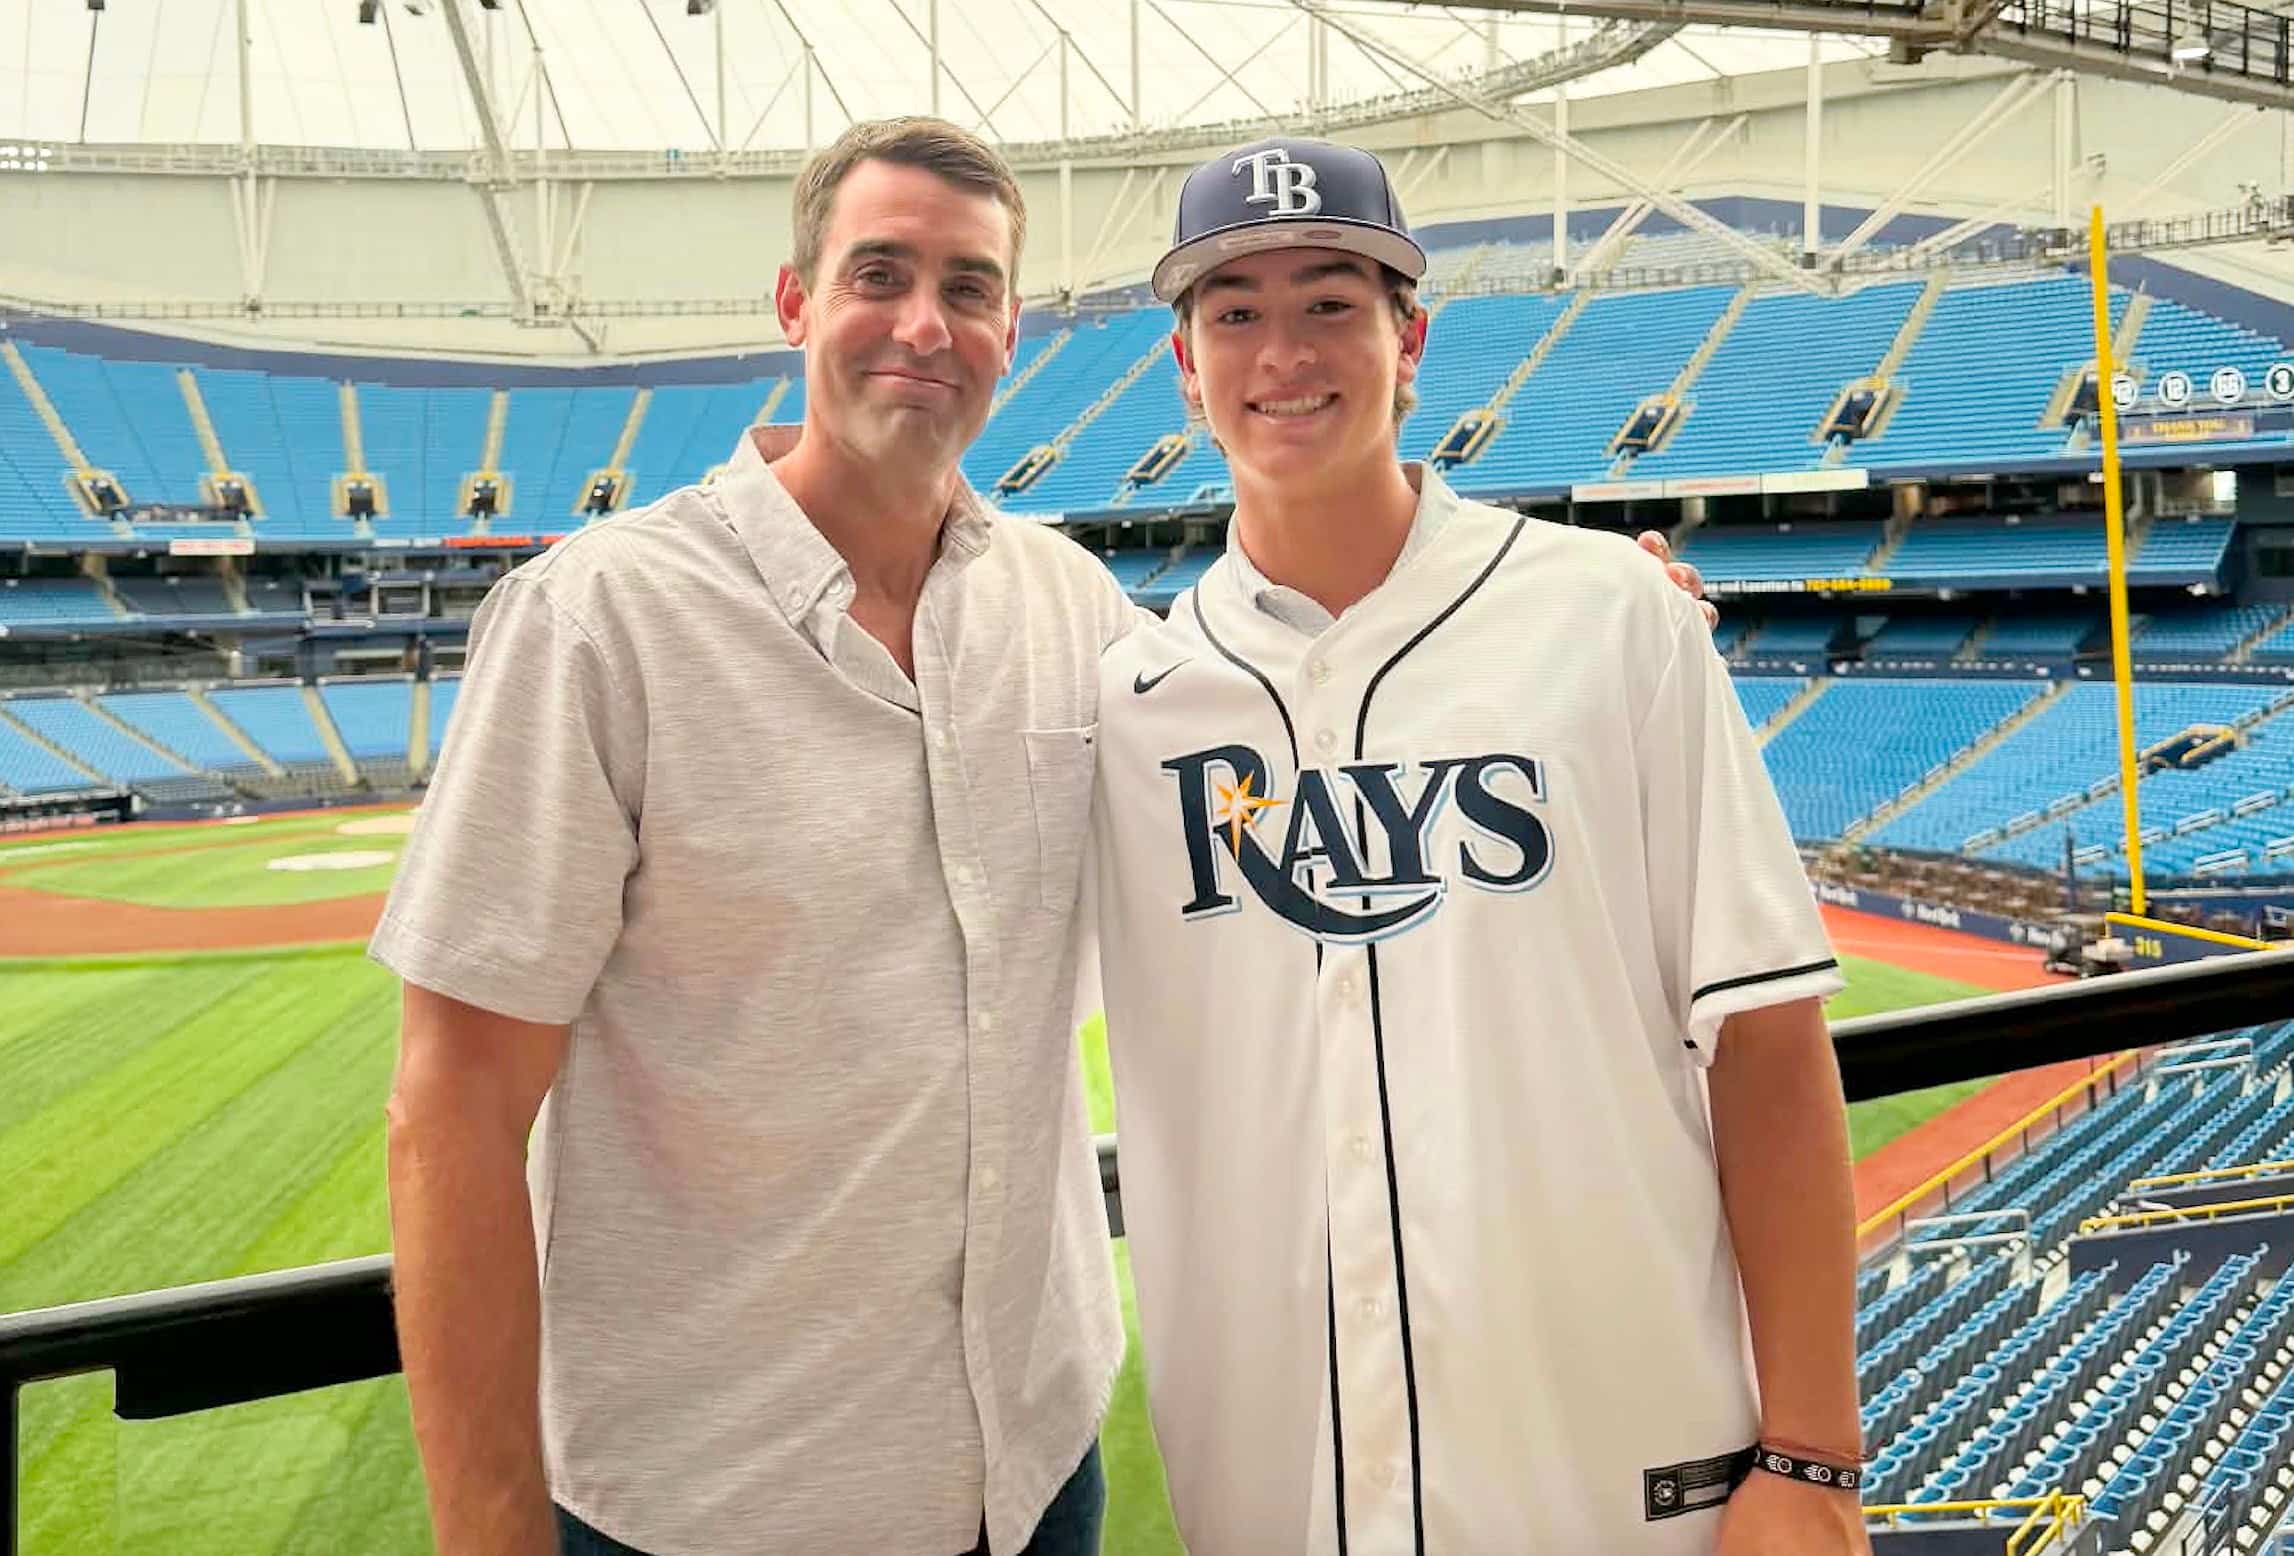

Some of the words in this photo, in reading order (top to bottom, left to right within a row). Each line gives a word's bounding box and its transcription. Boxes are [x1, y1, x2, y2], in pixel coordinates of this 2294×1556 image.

[1232, 148, 1322, 216] TB
[2275, 371, 2290, 393] 3
[1161, 745, 1554, 945] RAYS
